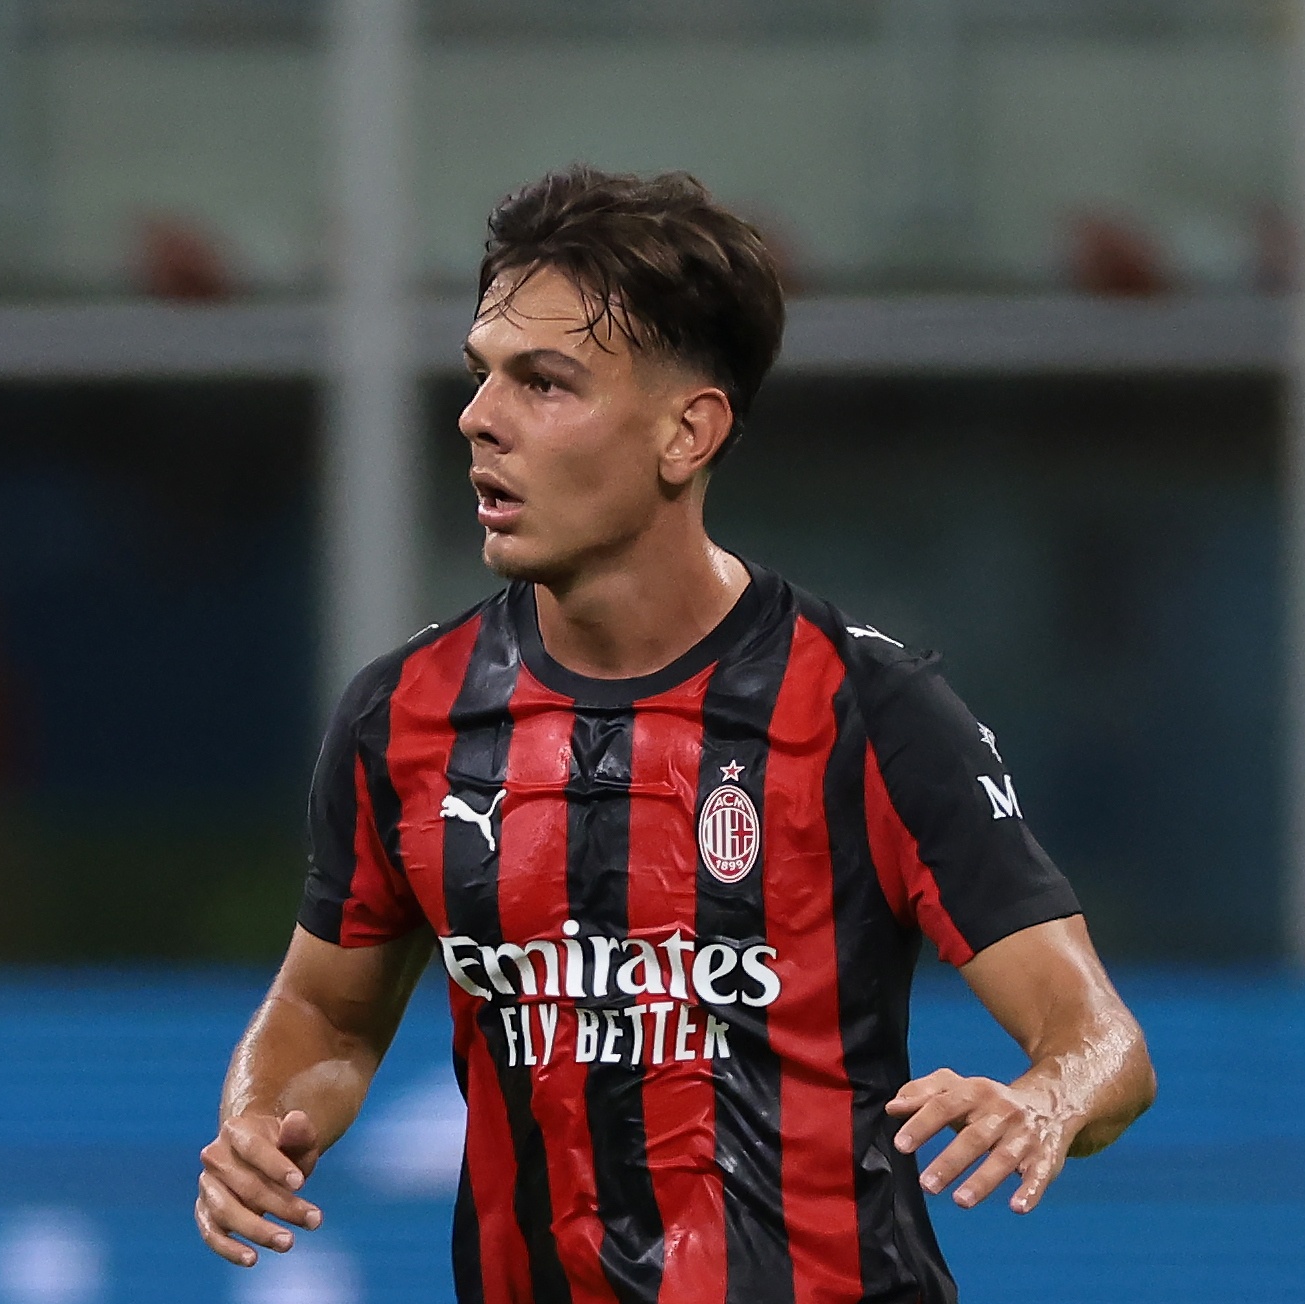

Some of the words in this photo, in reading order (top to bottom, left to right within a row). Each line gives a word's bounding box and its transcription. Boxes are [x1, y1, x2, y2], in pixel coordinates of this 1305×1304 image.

[712, 793, 746, 811] ACM
[715, 859, 744, 872] 1899
[438, 919, 782, 1007] Emirates
[499, 1003, 558, 1067] FLY
[574, 1001, 732, 1066] BETTER
